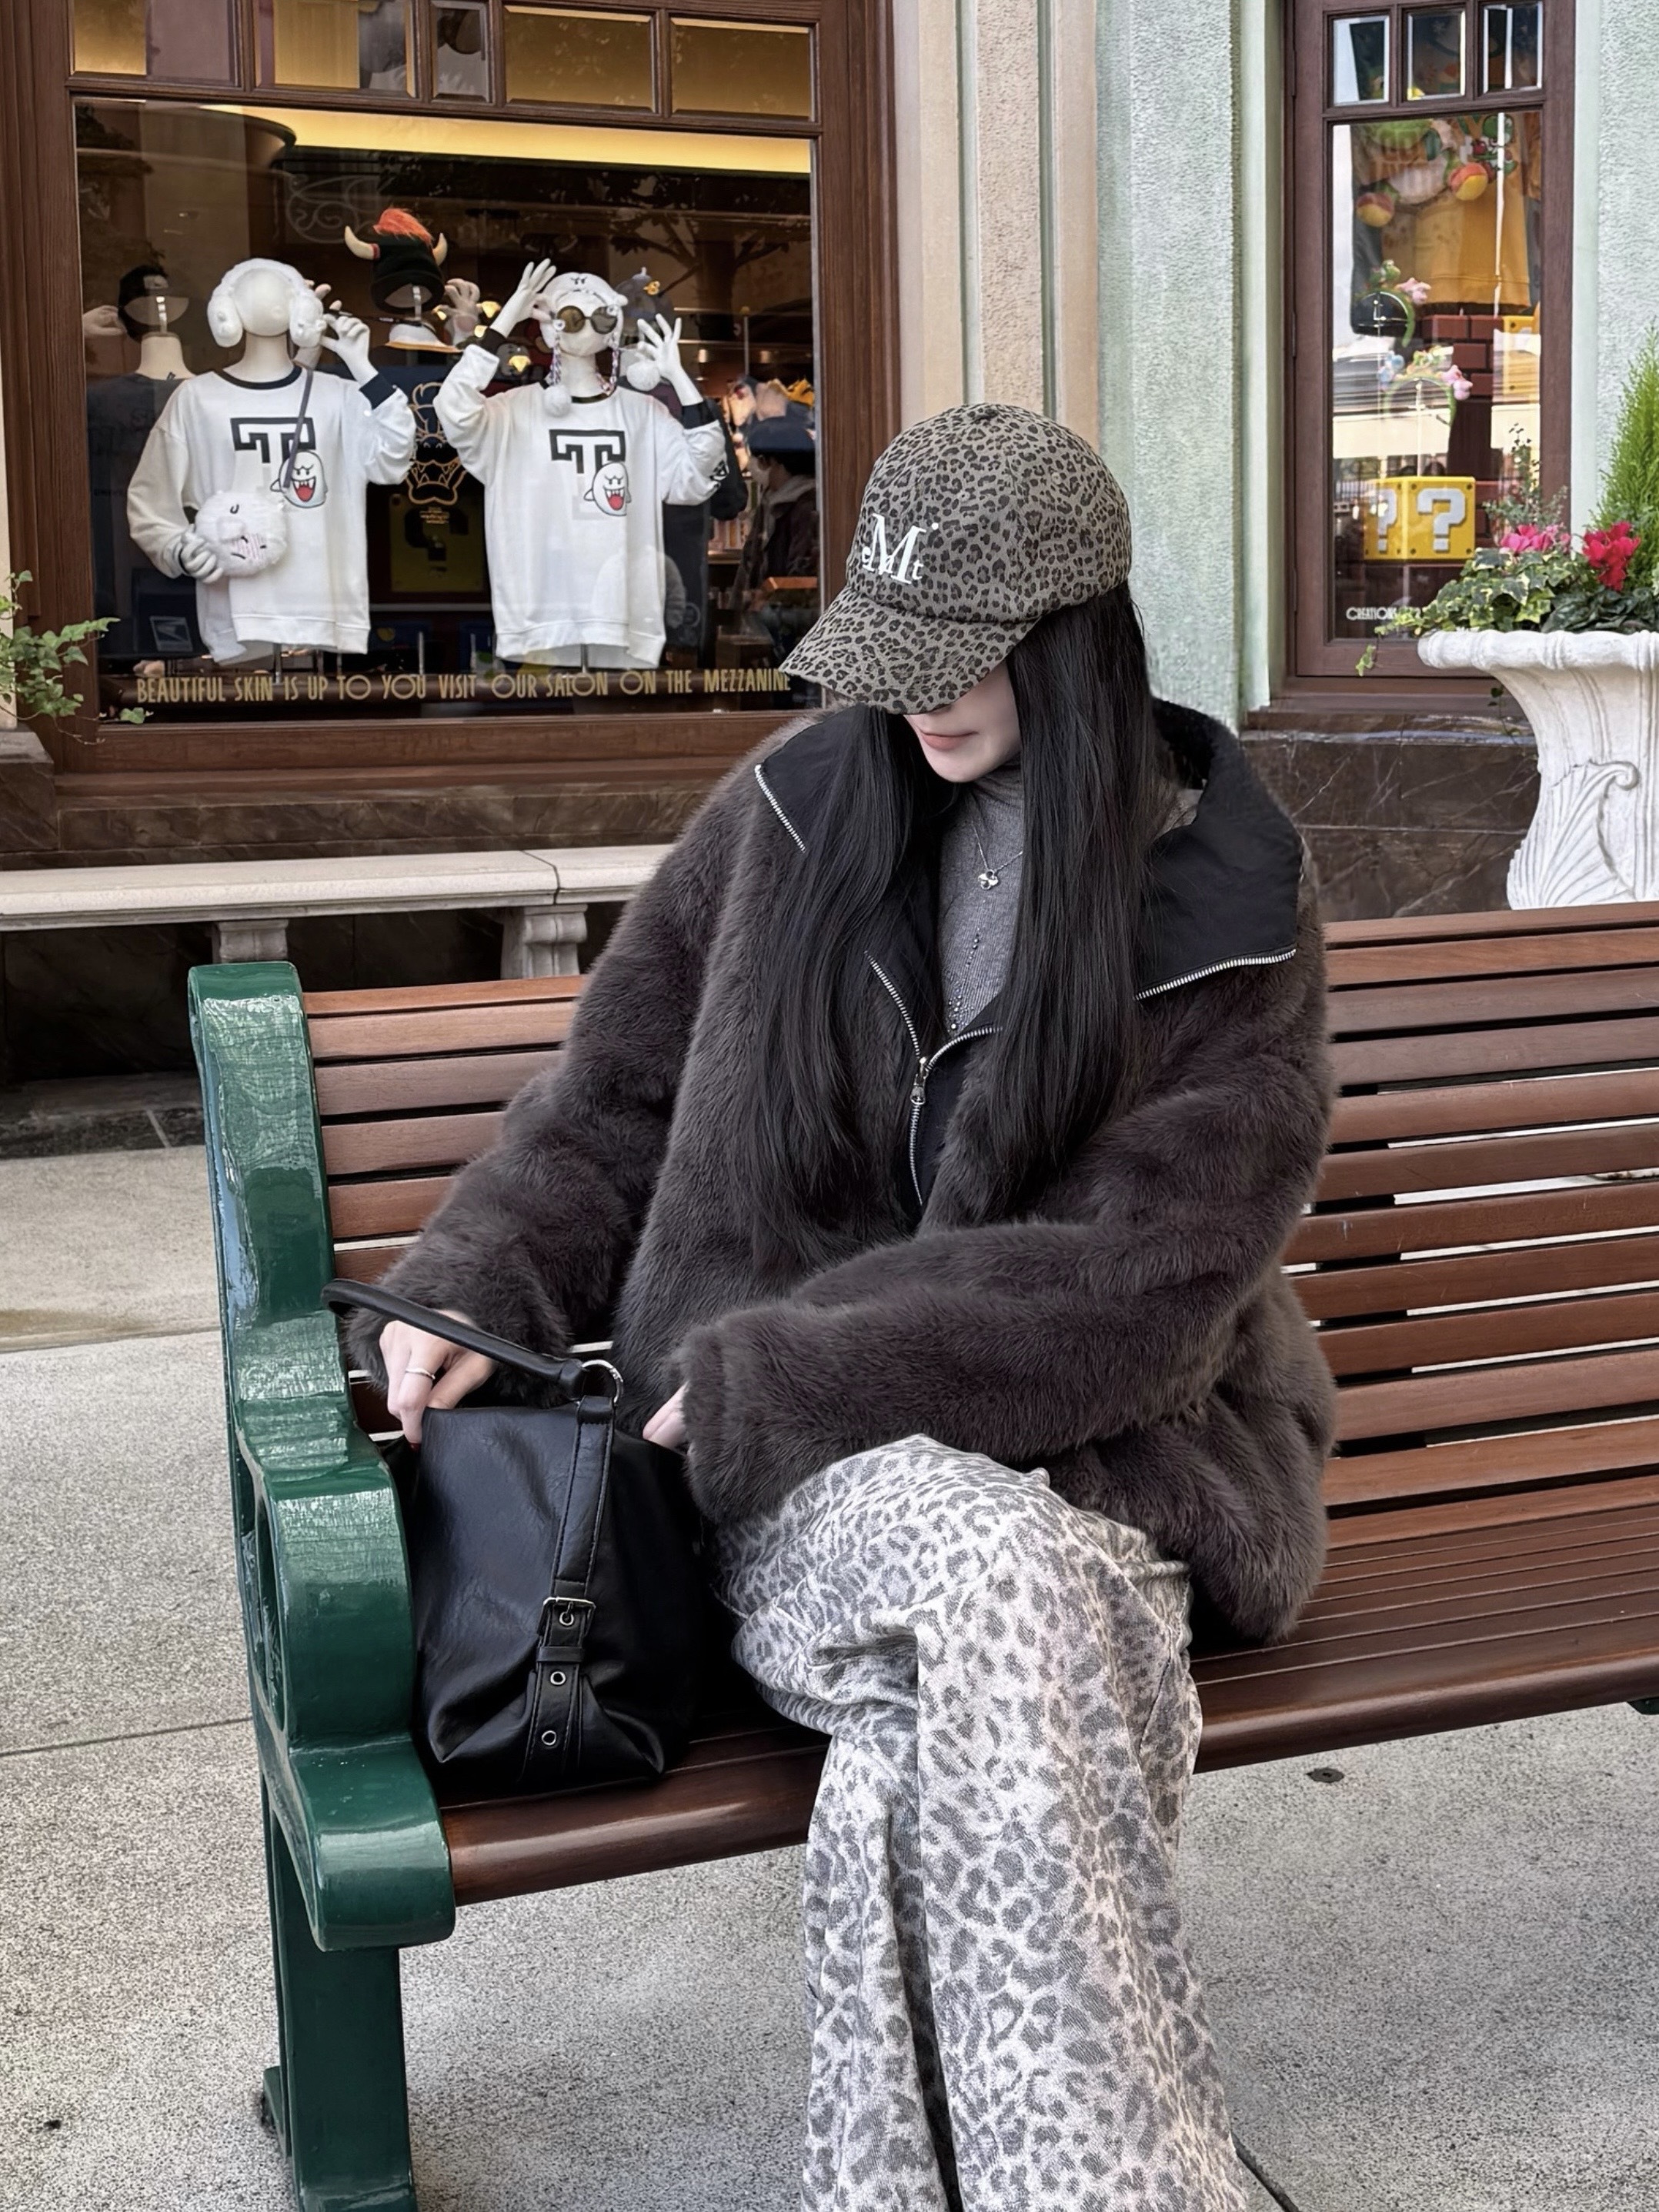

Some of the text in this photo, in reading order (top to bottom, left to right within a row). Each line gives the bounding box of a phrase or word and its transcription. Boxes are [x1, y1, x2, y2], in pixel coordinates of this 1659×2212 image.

[137, 668, 791, 702] BEAUTIFUL SKIN IS UP TO YOU VISIT OUR SALON ON THE MEZZANINE
